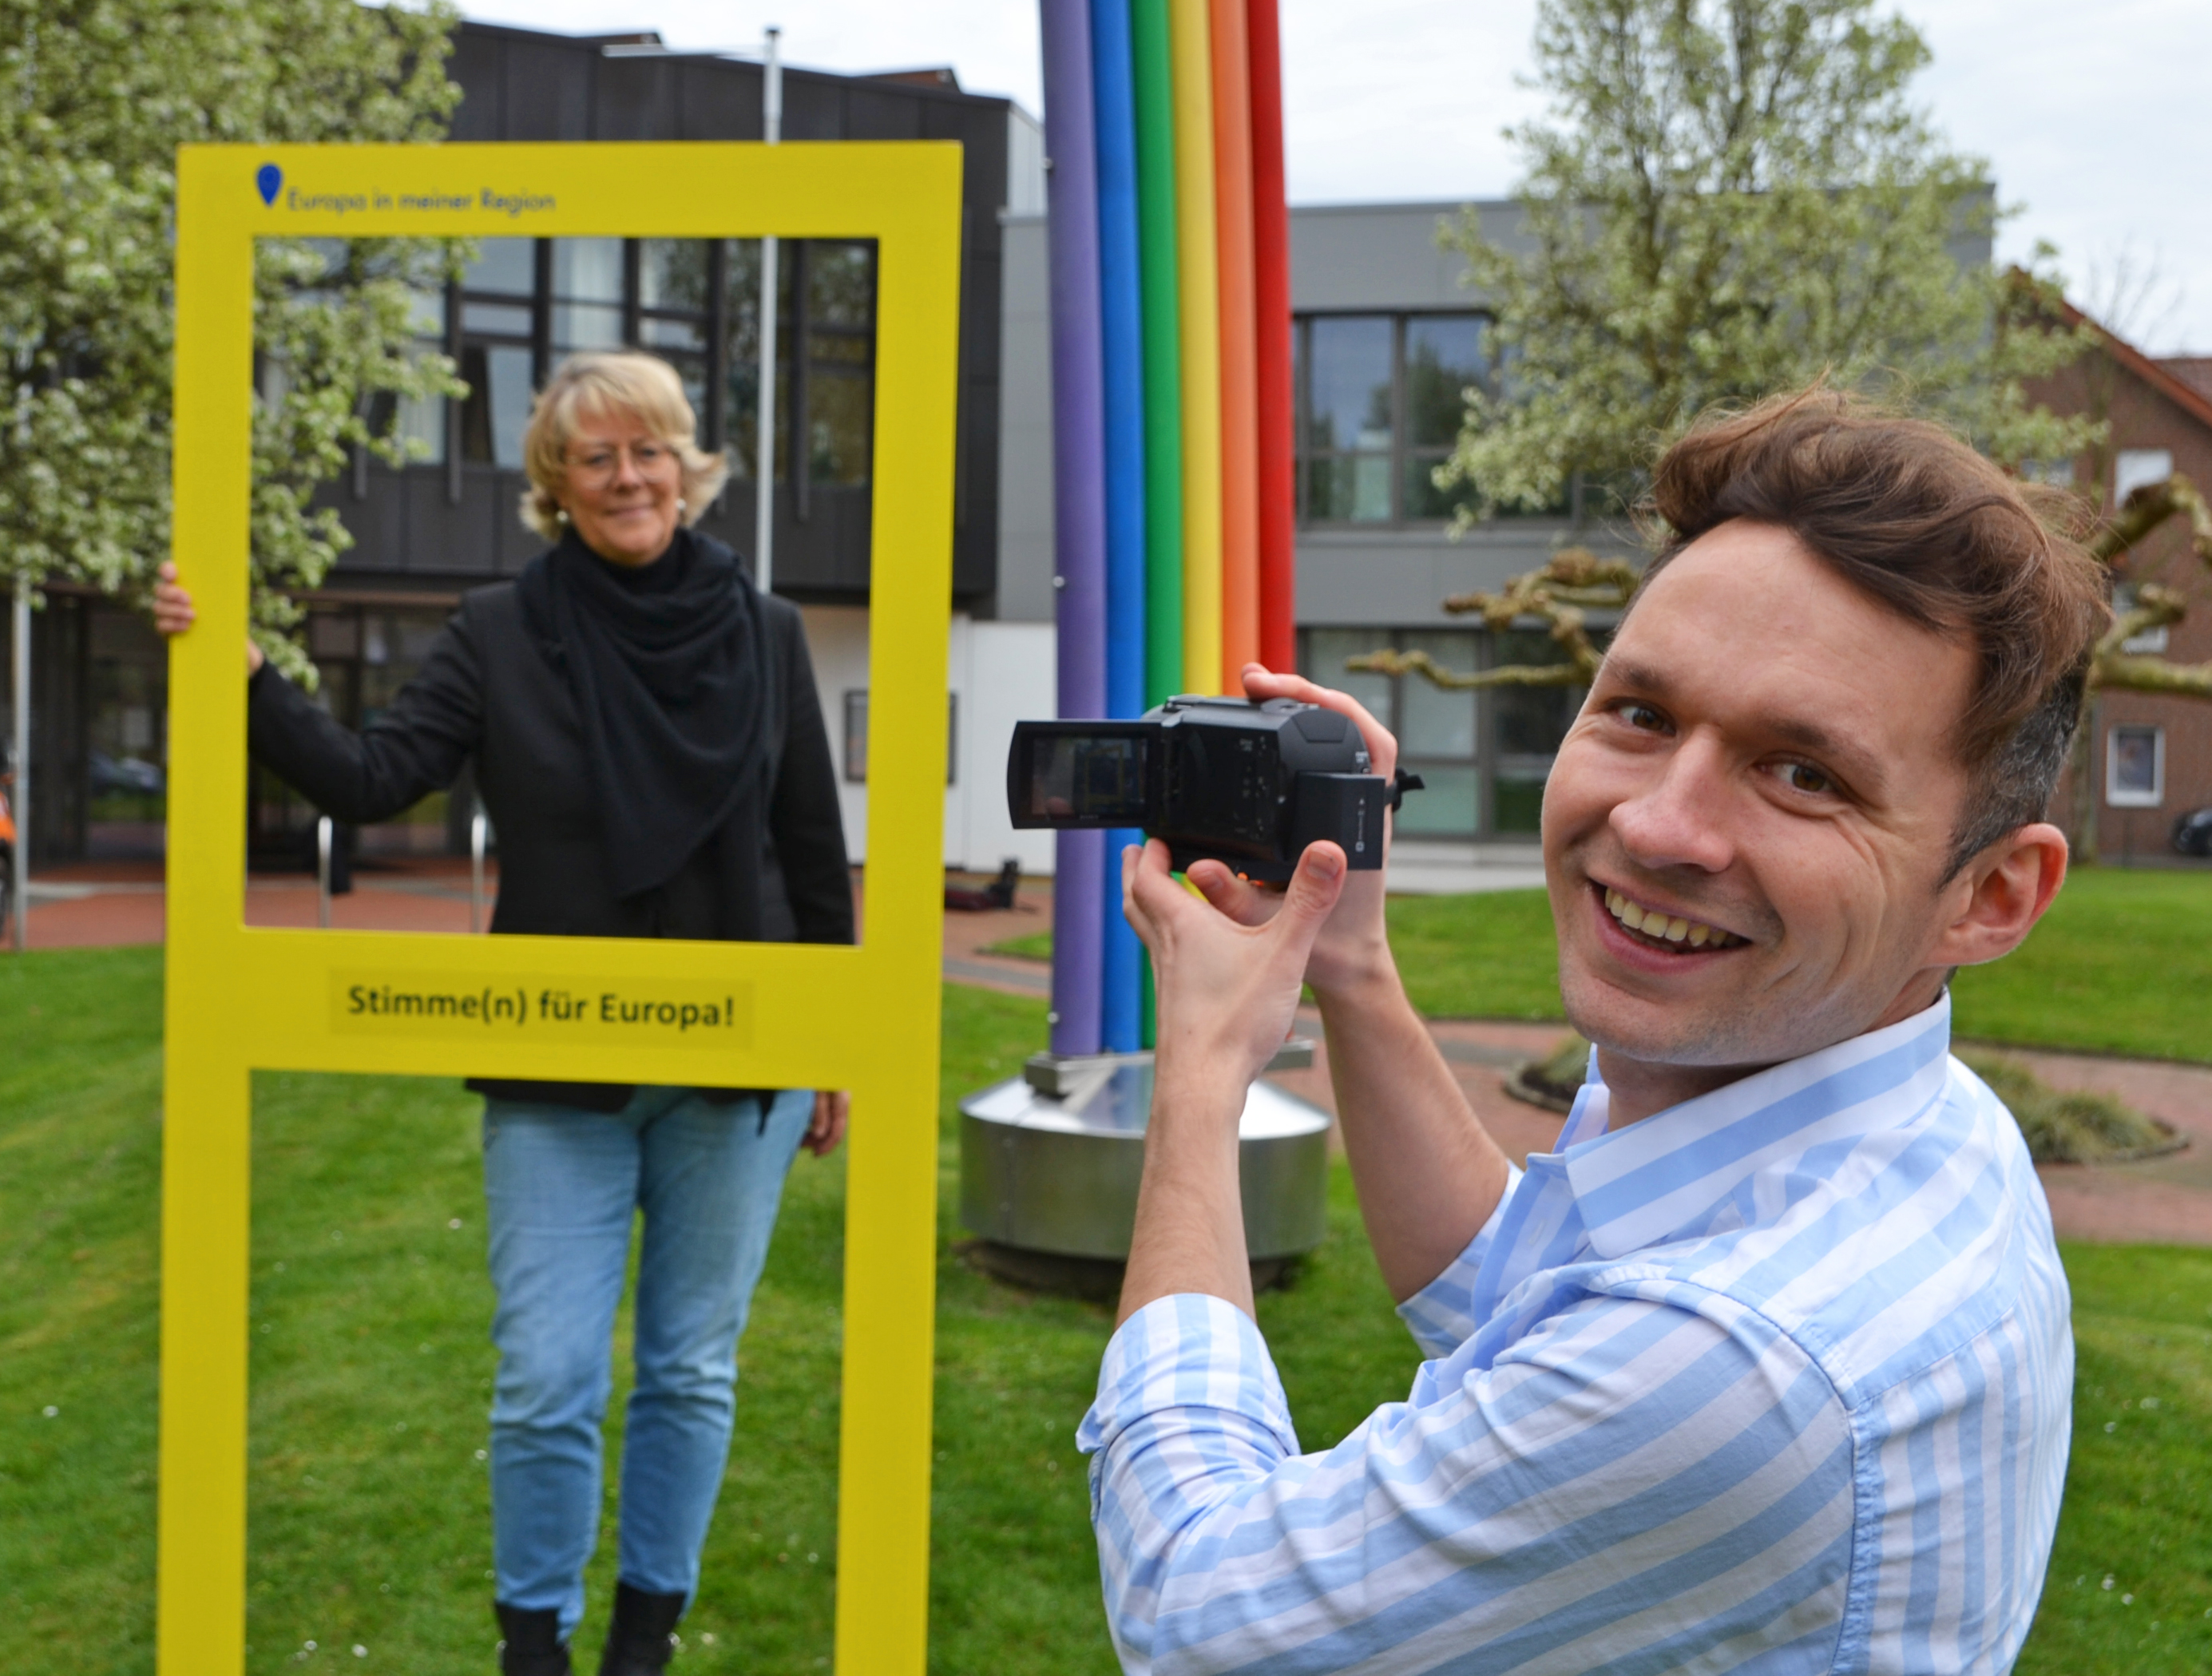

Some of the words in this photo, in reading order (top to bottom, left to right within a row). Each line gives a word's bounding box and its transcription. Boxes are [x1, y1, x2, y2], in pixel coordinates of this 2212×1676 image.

[288, 188, 367, 216] Europa
[373, 188, 393, 211] in
[399, 188, 472, 211] meiner
[482, 188, 557, 219] Region
[347, 985, 528, 1025] Stimme(n)
[539, 989, 589, 1021] für
[601, 993, 734, 1031] Europa!
